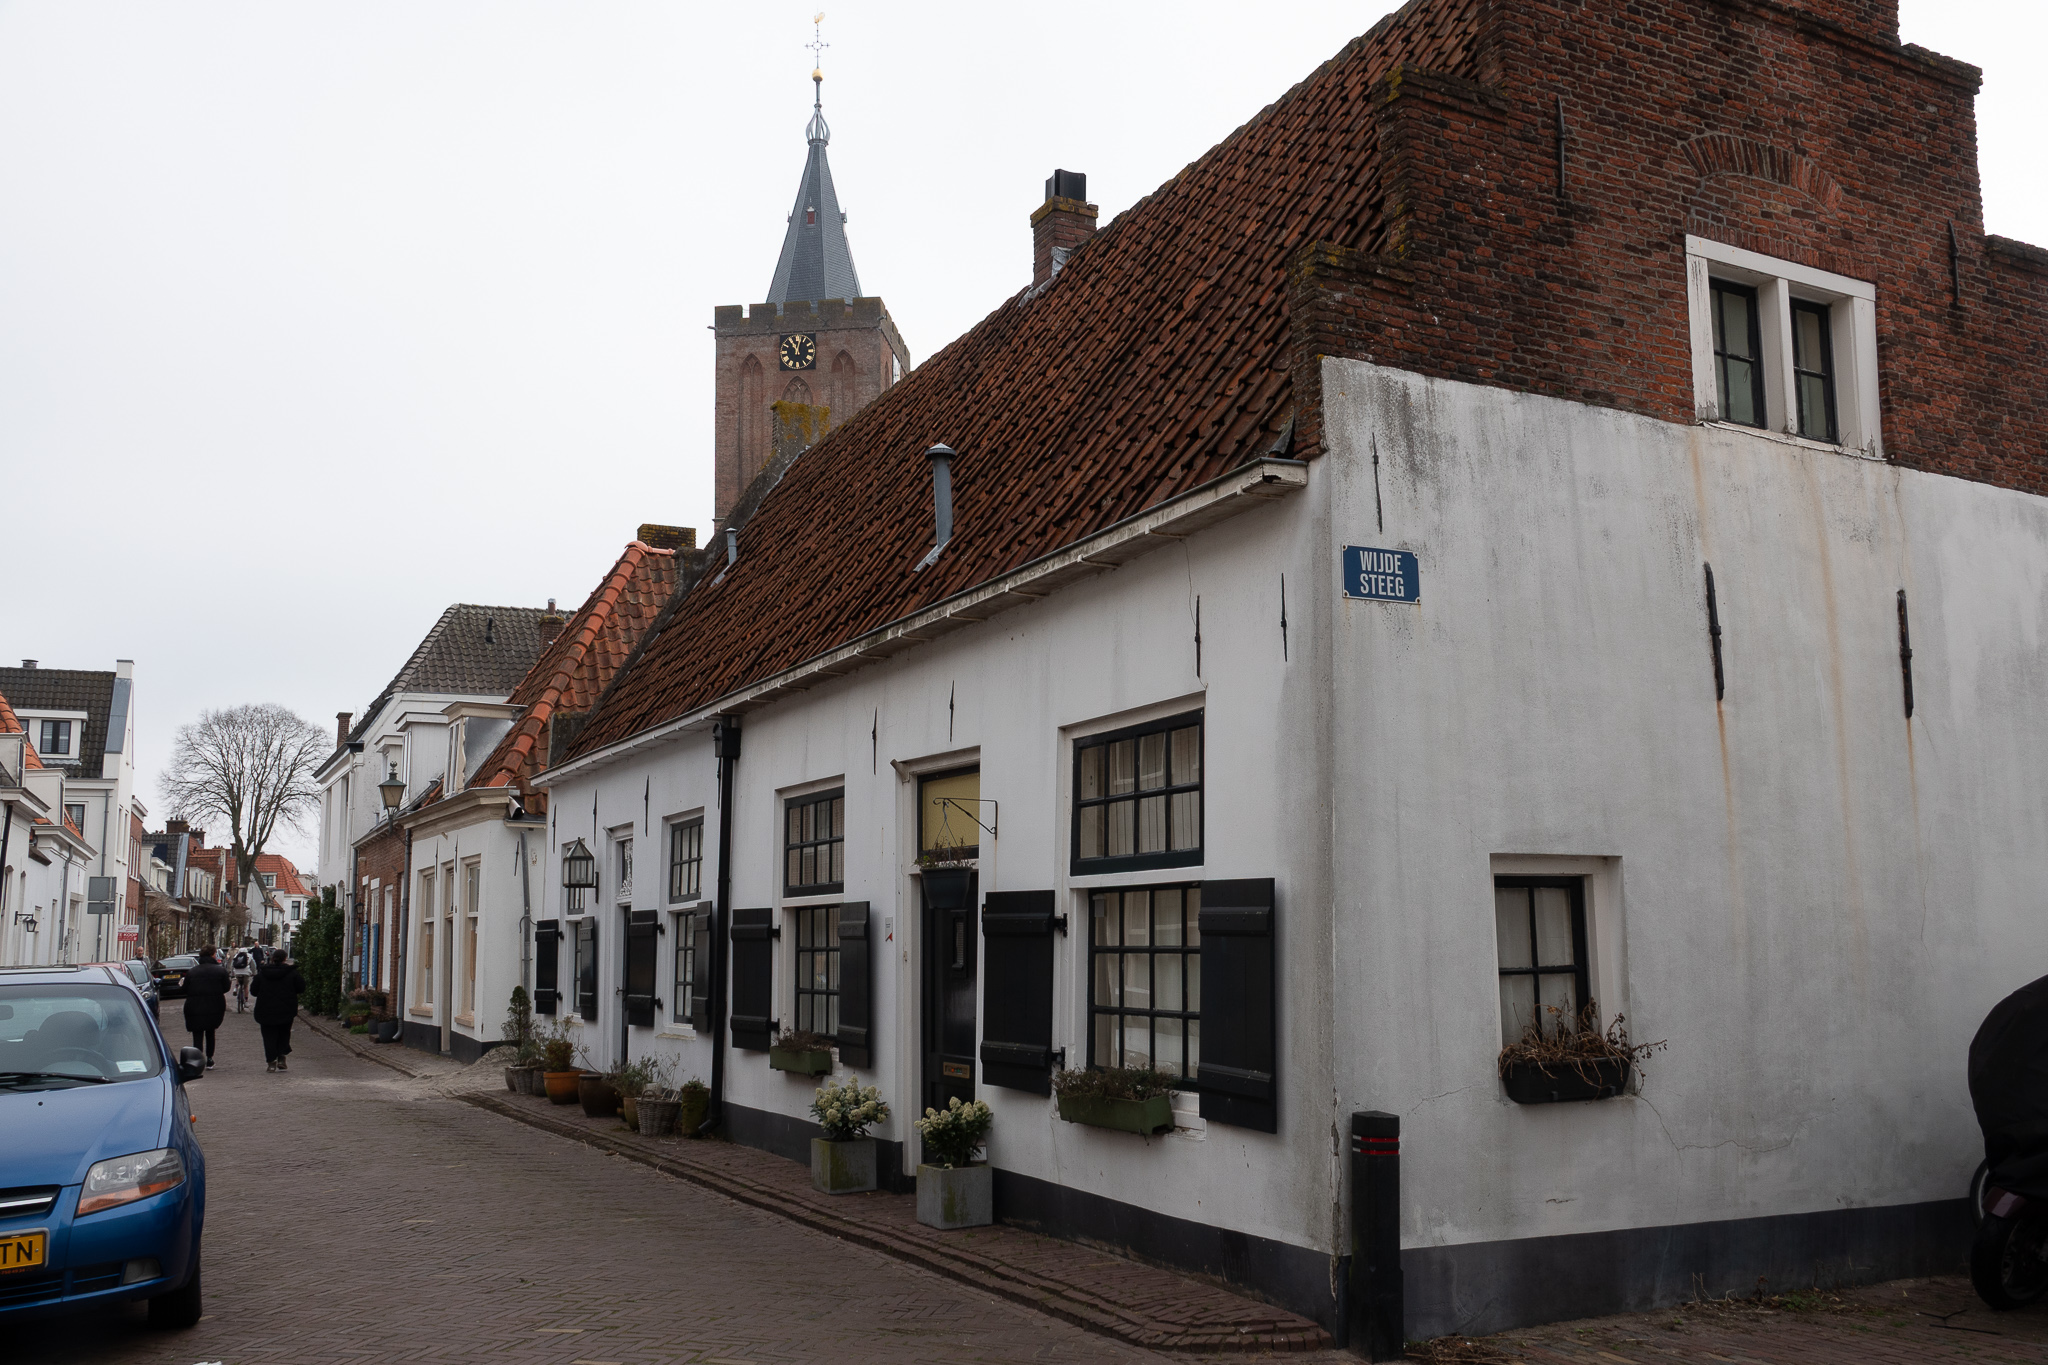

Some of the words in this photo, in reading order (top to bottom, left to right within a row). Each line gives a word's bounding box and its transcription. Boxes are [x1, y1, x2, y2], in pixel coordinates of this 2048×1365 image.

[1360, 550, 1403, 575] WIJDE
[1360, 573, 1405, 597] STEEG
[0, 1240, 33, 1264] TN
